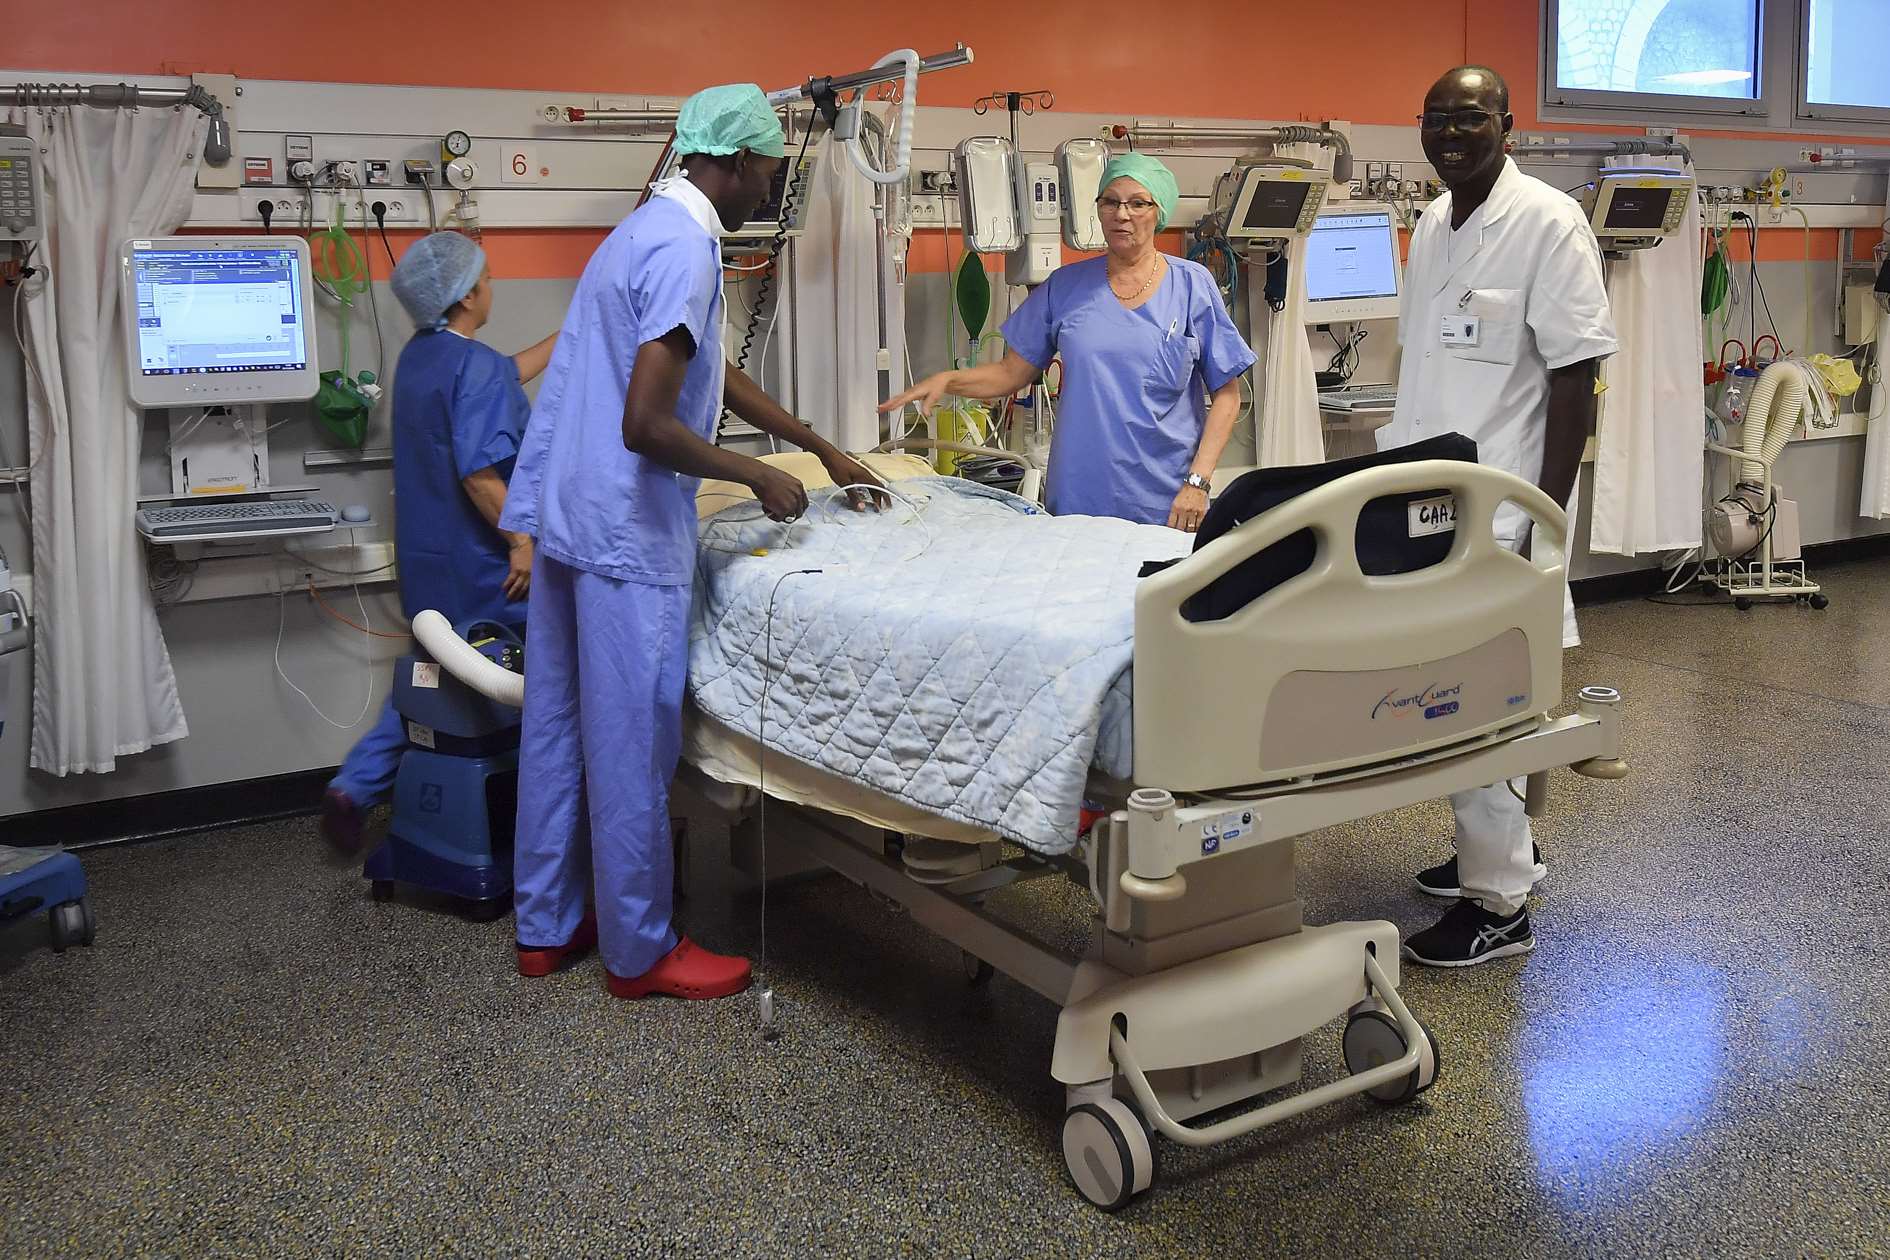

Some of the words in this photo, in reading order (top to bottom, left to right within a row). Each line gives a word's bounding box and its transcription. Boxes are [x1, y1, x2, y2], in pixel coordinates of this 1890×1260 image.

[513, 154, 526, 175] 6
[1796, 181, 1803, 195] 3
[1204, 839, 1217, 849] NF
